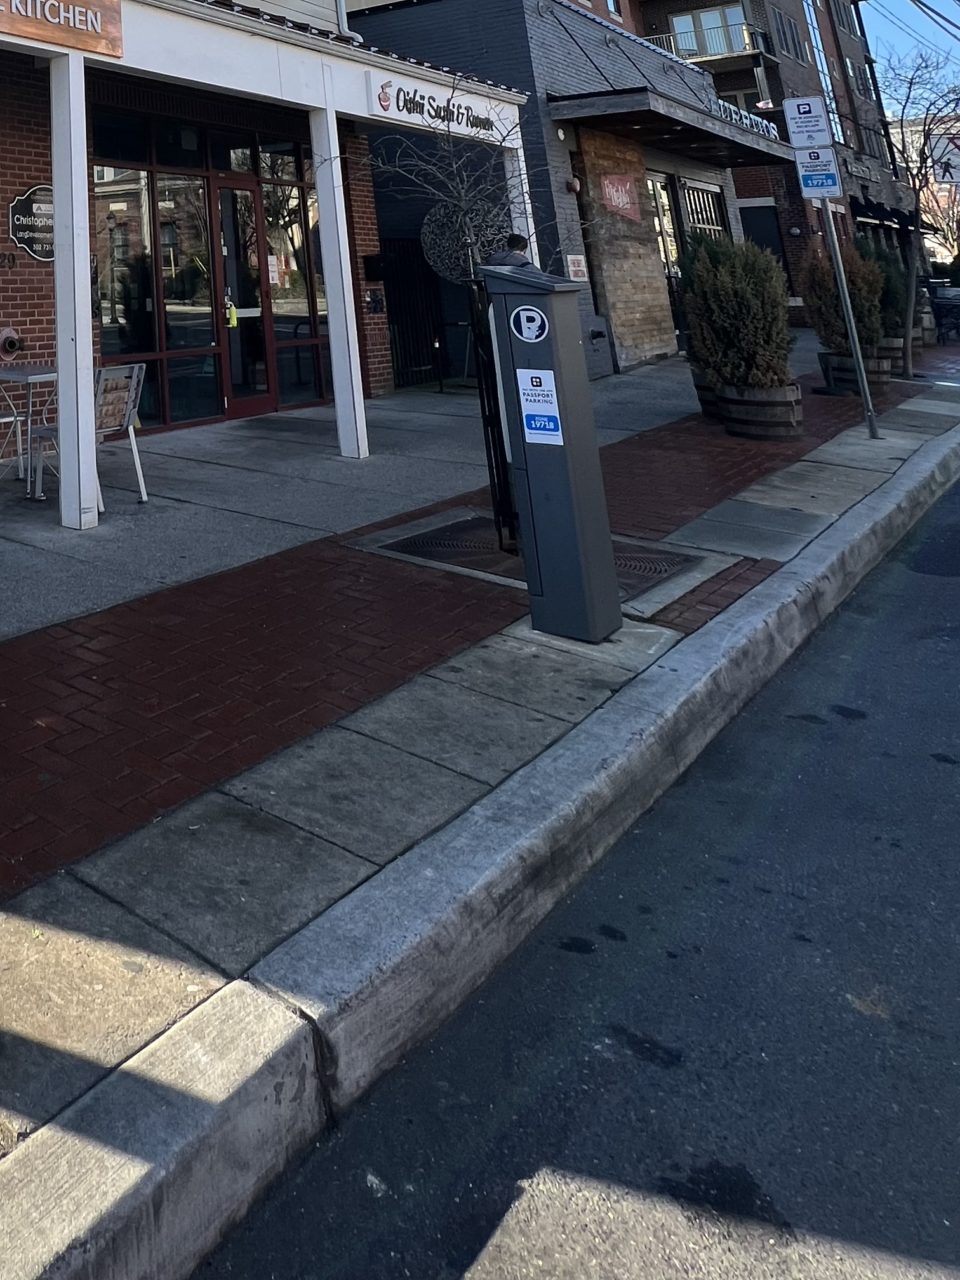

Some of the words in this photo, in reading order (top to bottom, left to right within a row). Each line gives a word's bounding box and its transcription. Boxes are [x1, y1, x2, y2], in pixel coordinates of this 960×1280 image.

[396, 87, 426, 116] Oishii
[427, 95, 456, 123] Sushi
[456, 103, 465, 126] &
[522, 391, 554, 399] PASSPORT
